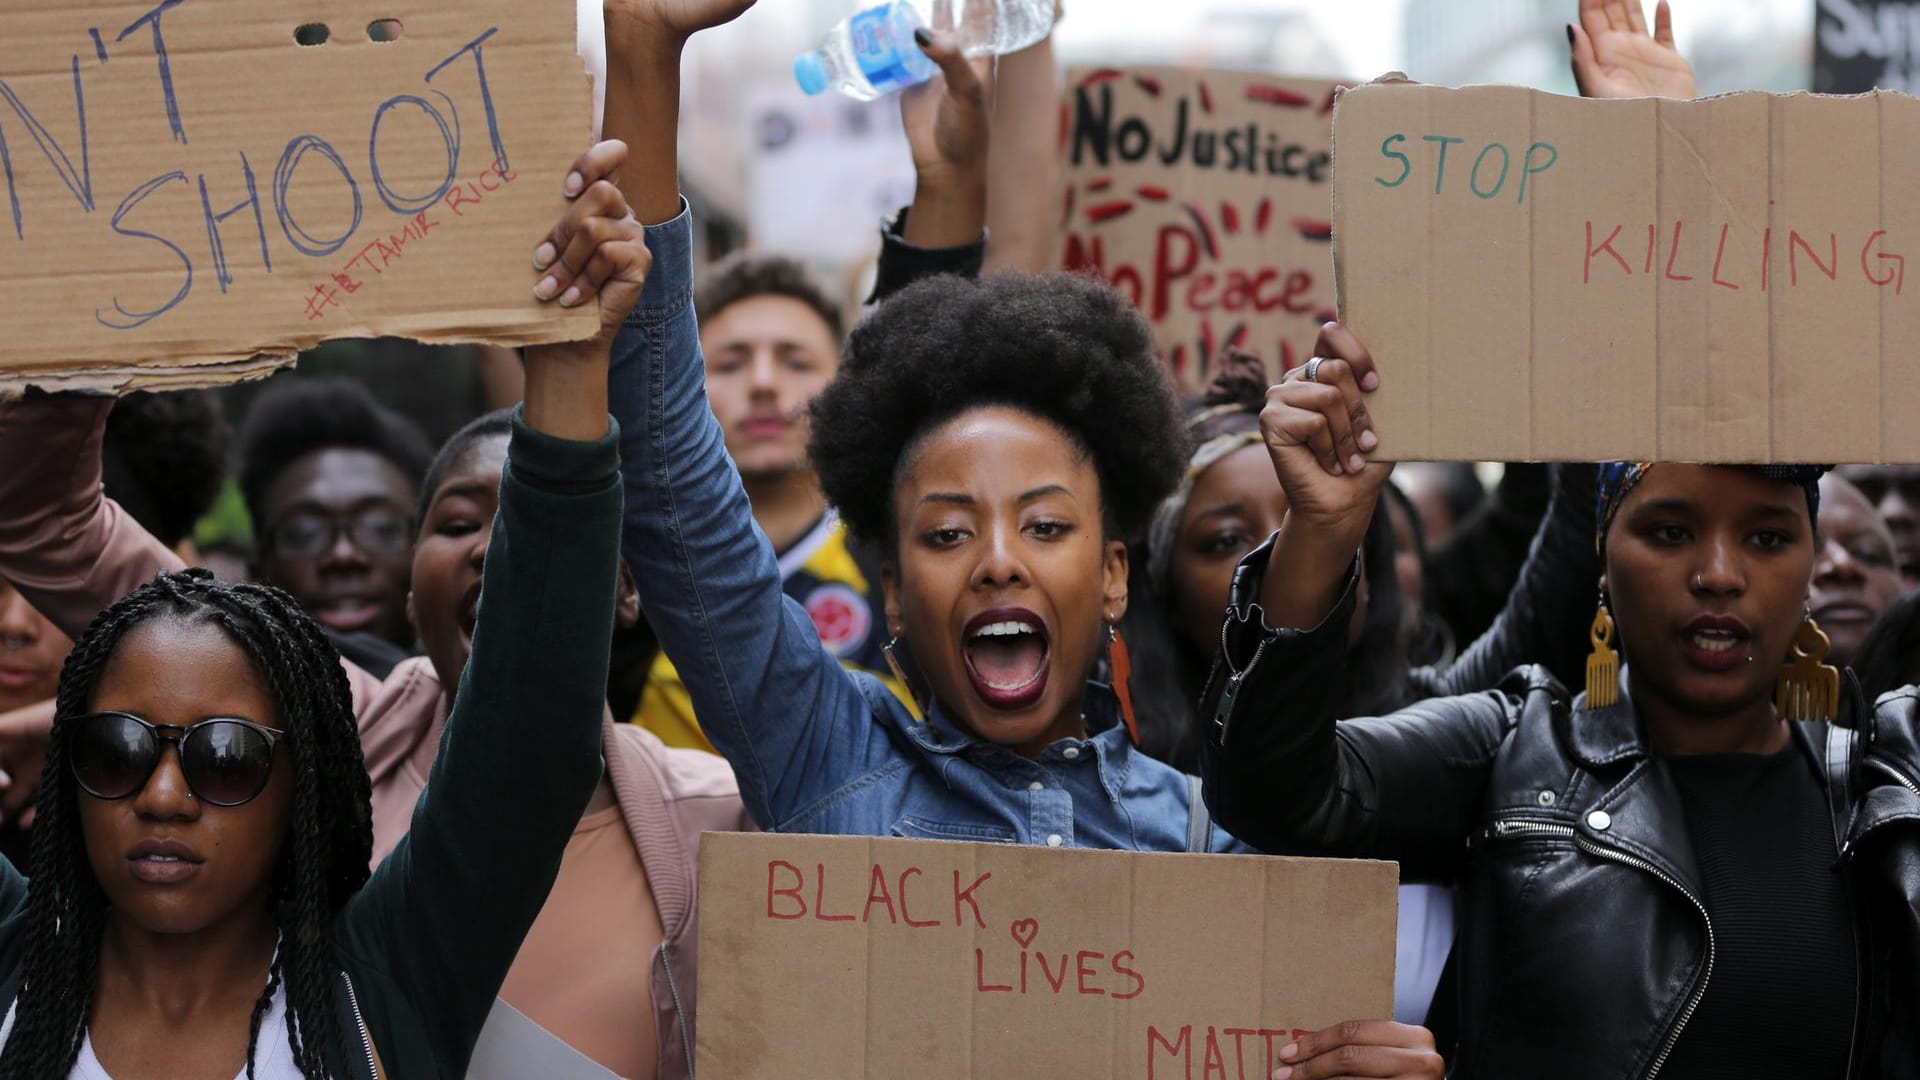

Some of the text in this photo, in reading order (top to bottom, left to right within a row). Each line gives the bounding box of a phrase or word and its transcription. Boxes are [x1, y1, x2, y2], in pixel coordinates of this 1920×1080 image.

[1070, 84, 1332, 182] No Justice
[1374, 133, 1557, 204] STOP
[96, 27, 509, 329] SHOOT
[444, 156, 517, 216] RICE
[1151, 224, 1315, 323] Peace
[1584, 220, 1904, 295] KILLING
[767, 860, 992, 929] BLACK
[975, 948, 1145, 1000] LIVES
[1147, 1024, 1316, 1080] MATT
